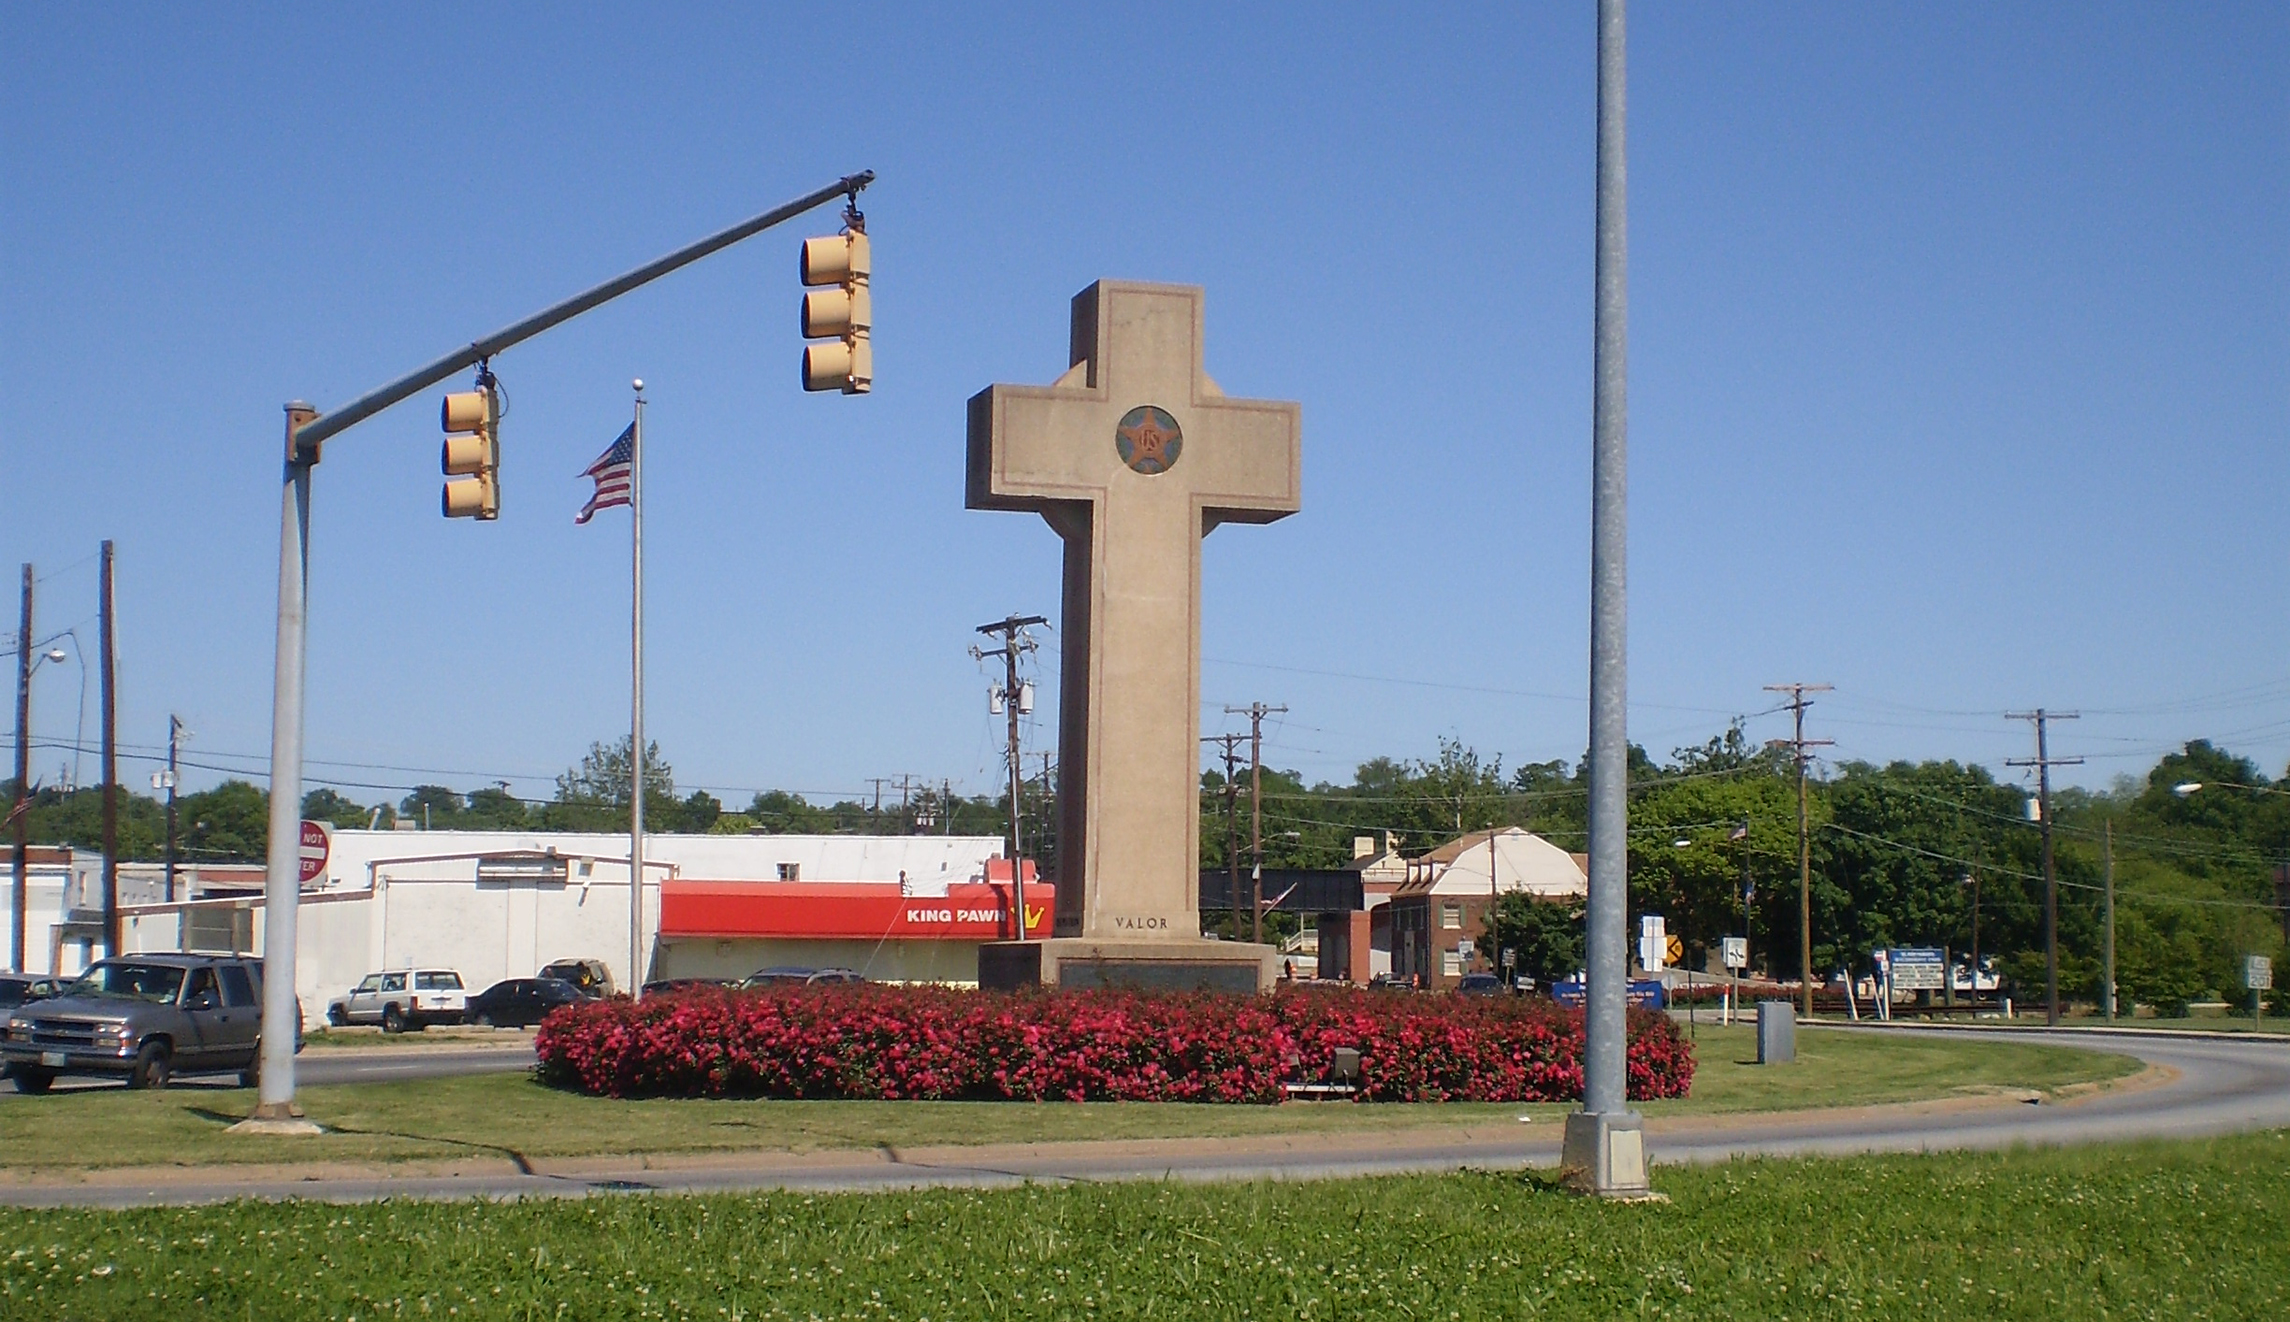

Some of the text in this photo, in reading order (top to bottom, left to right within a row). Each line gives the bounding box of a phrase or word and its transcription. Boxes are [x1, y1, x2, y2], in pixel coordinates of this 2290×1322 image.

[303, 833, 323, 845] NOT
[299, 861, 316, 872] TER
[906, 909, 1007, 923] KING PAWN
[1115, 917, 1169, 930] VALOR
[2250, 976, 2270, 987] 201
